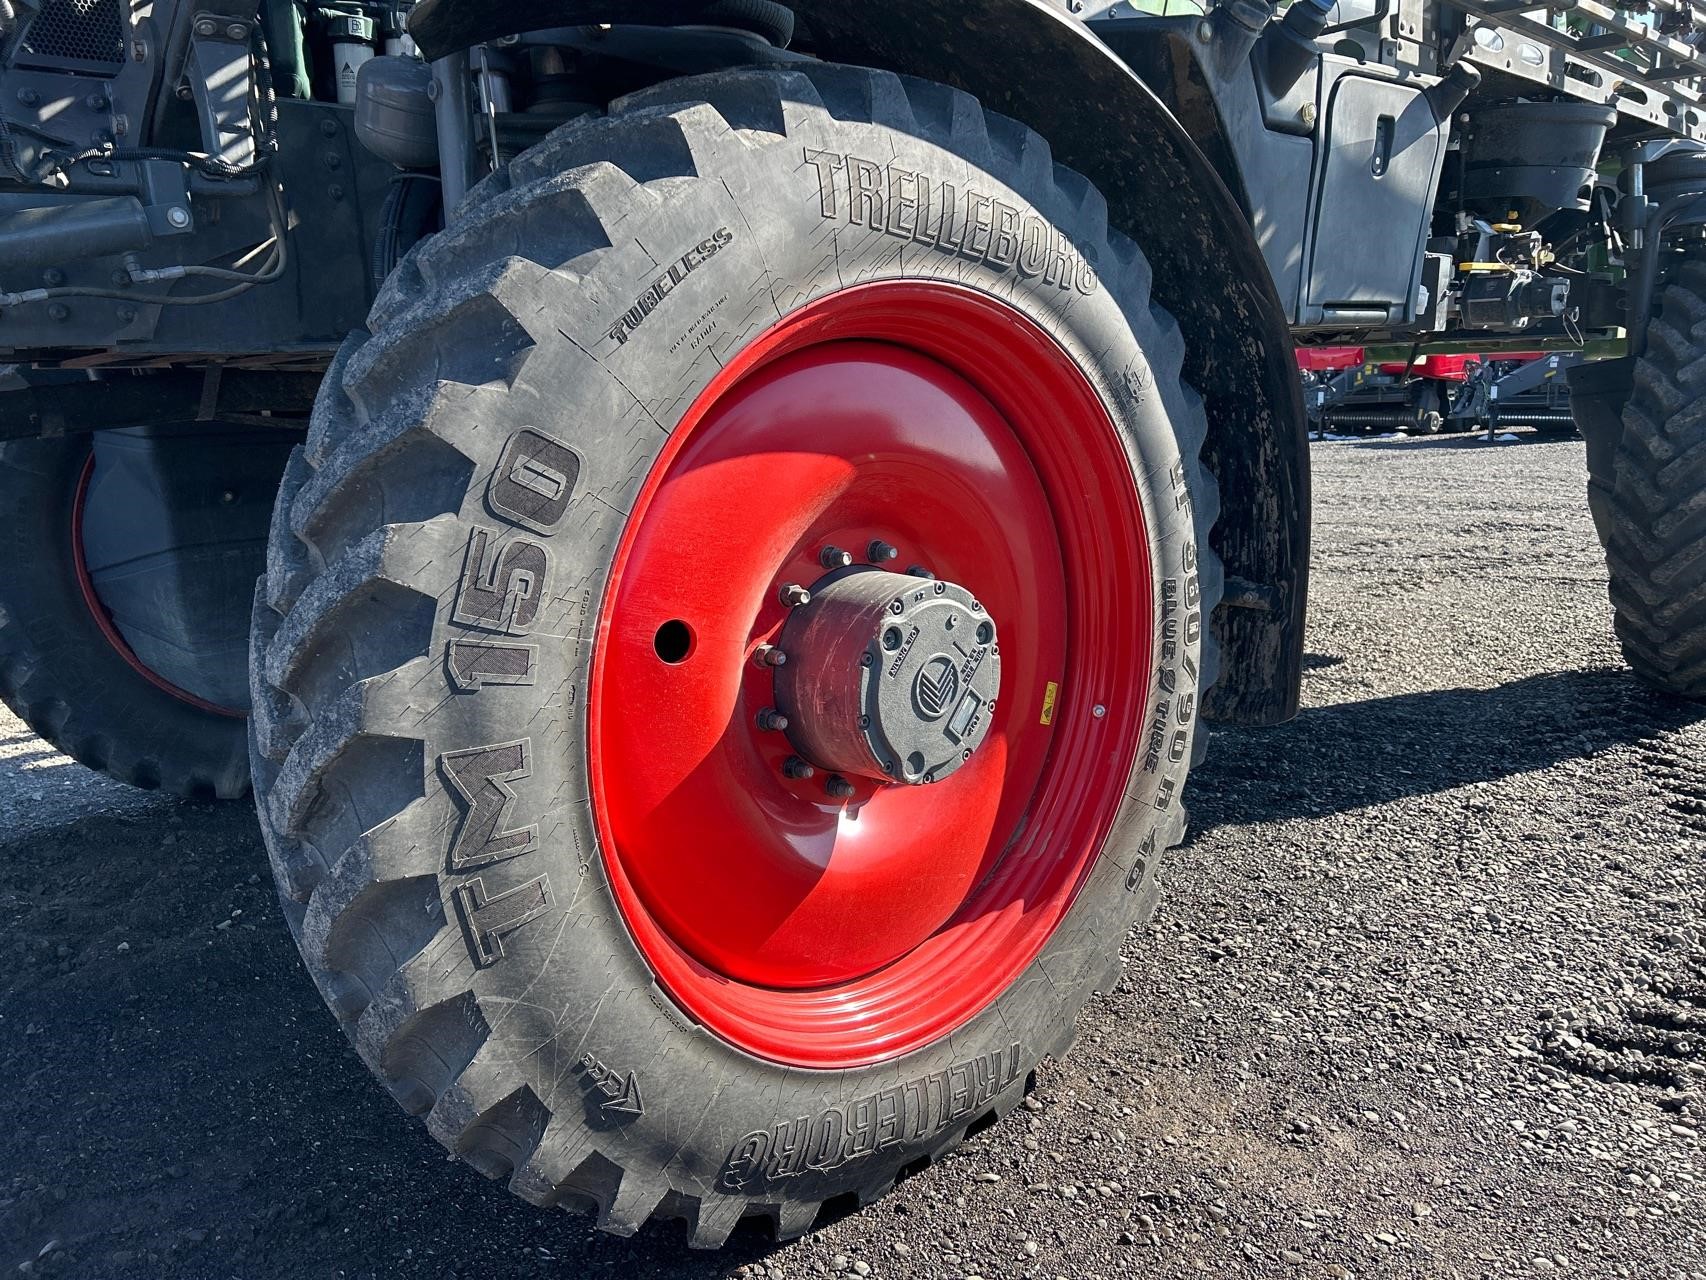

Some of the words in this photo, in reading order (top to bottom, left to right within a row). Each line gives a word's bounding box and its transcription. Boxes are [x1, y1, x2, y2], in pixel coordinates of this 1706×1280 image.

[804, 147, 1099, 296] TRELLEBORG
[609, 226, 733, 345] TUBELESS
[1170, 455, 1192, 518] VF
[445, 425, 588, 691] 150
[904, 627, 919, 646] OIL
[1161, 578, 1178, 661] BLUE
[888, 646, 907, 678] DRAIN
[1144, 699, 1171, 774] TIRE
[441, 737, 556, 969] TM
[1125, 825, 1156, 895] 46
[723, 1041, 1022, 1190] TRELLEBORG
